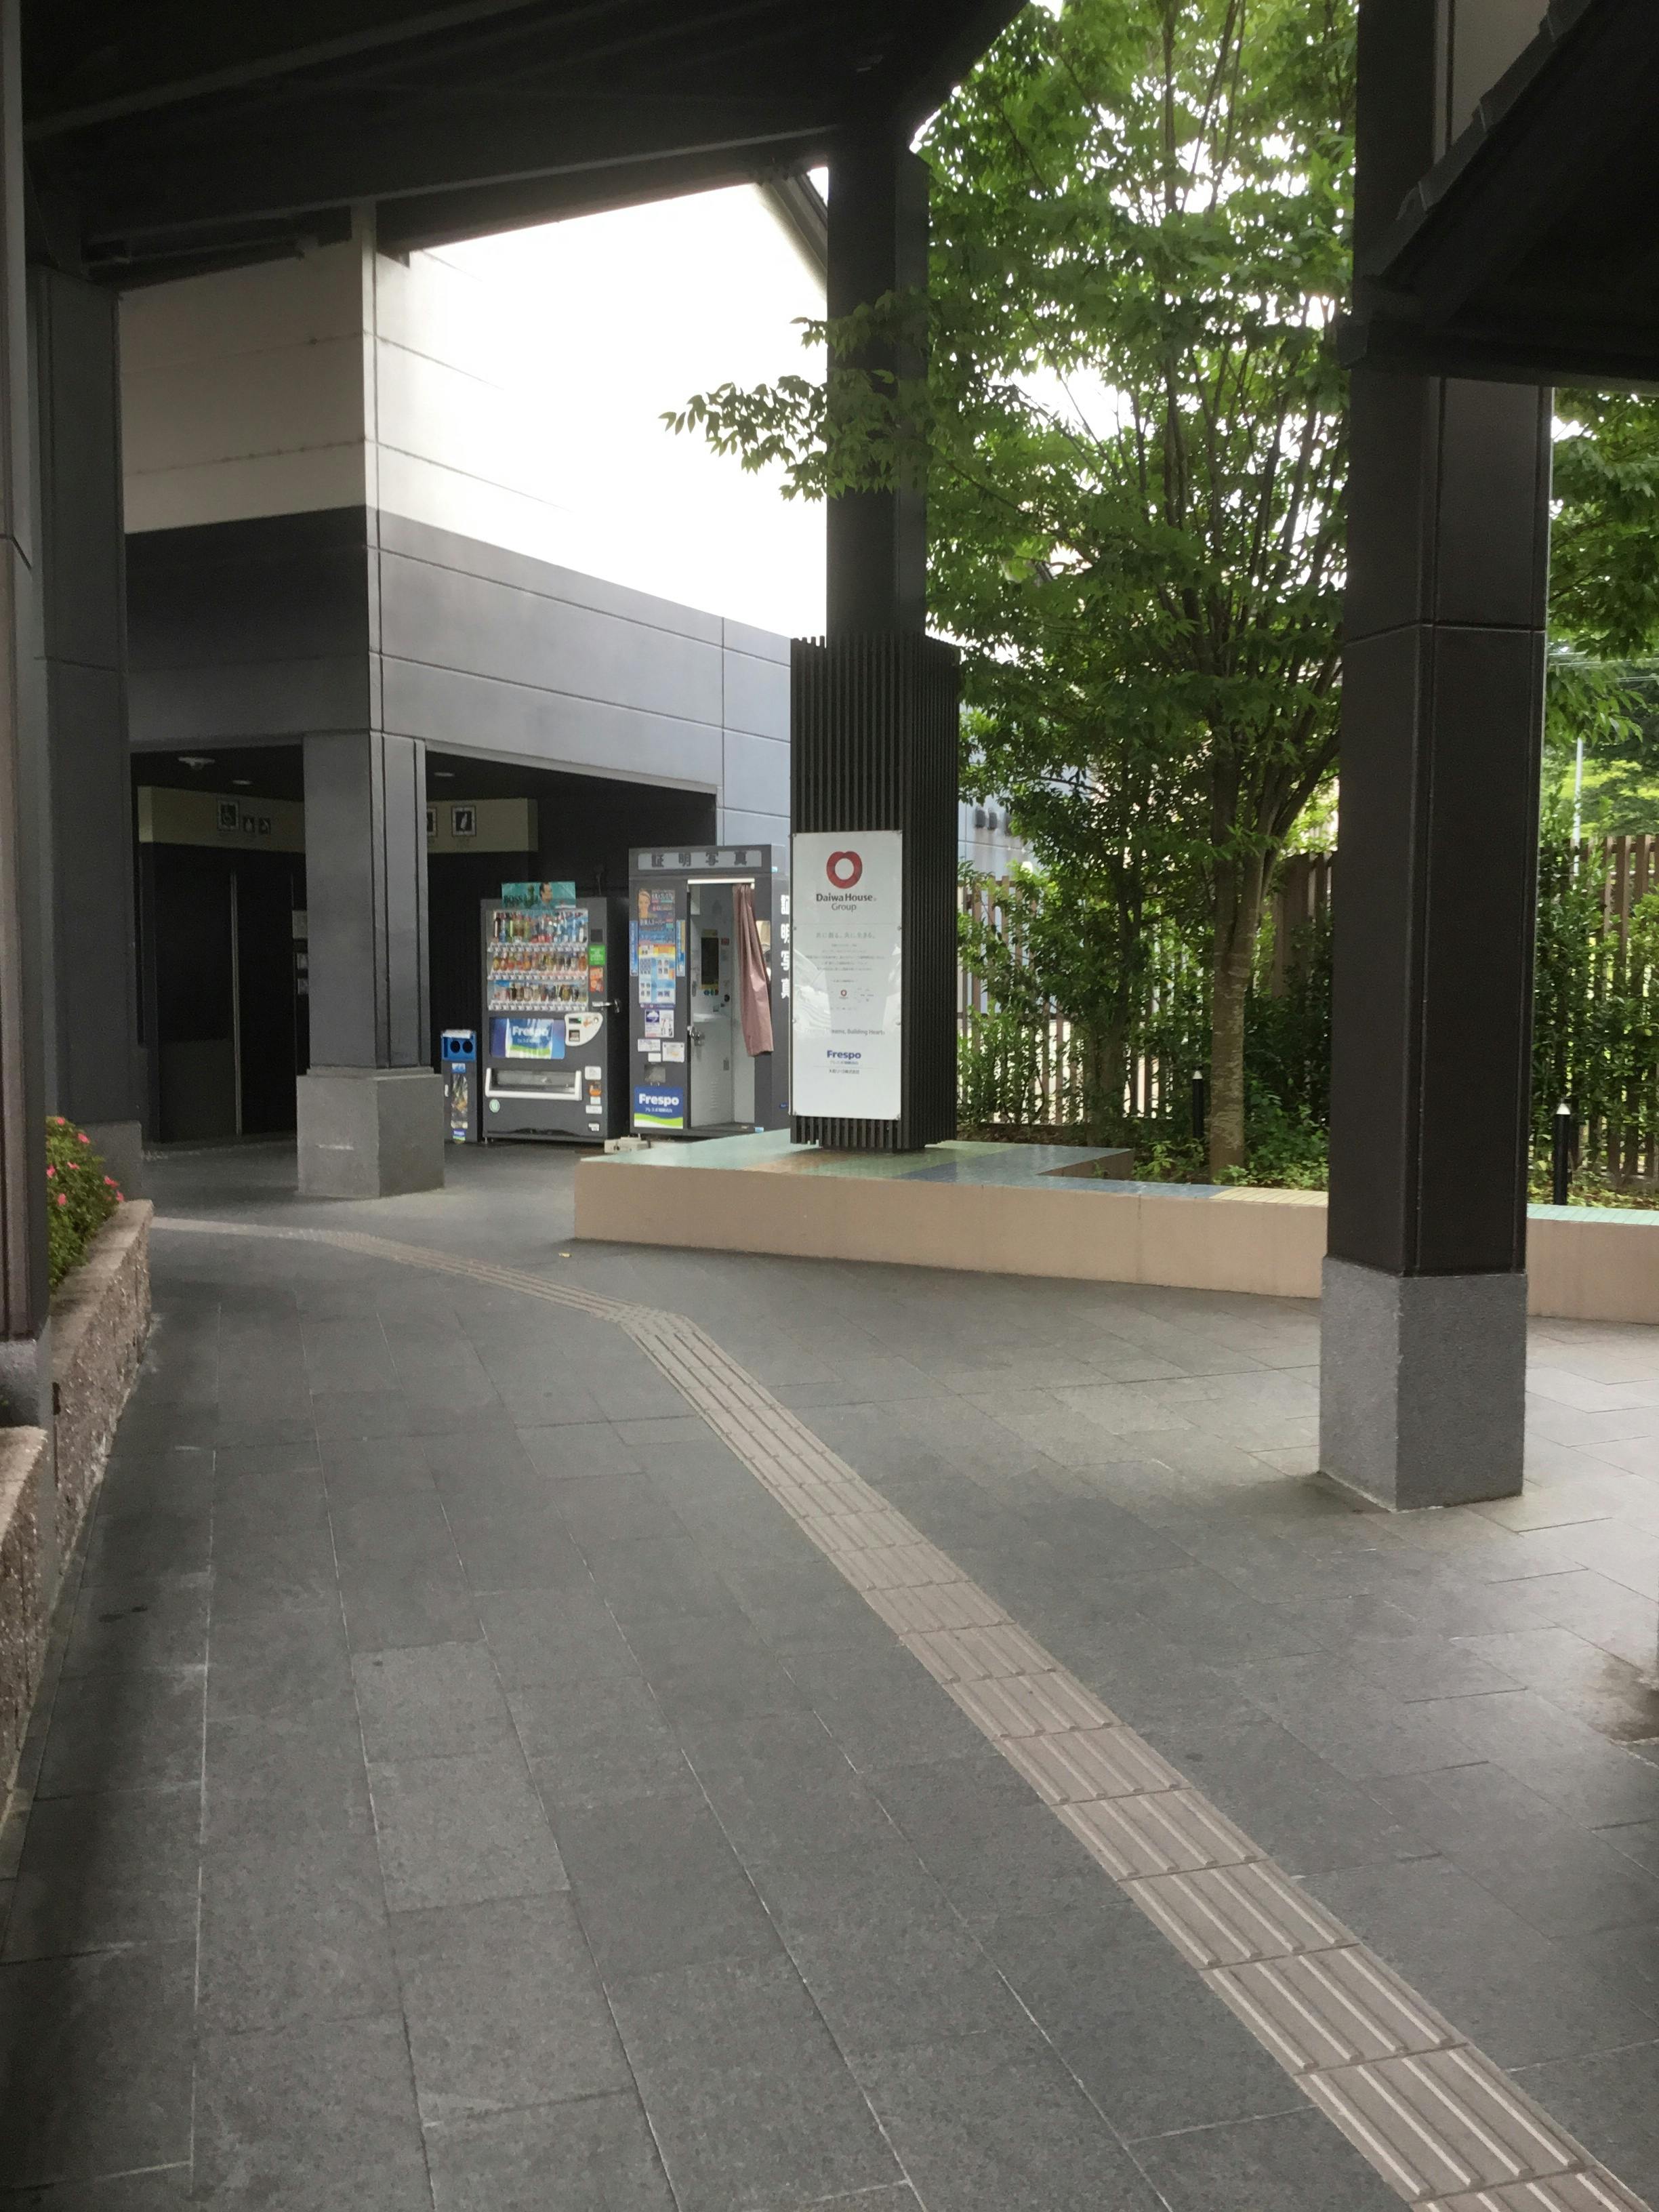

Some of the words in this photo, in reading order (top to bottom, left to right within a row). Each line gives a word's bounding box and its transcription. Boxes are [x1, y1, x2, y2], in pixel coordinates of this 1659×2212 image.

[651, 851, 747, 867] 証明写真
[816, 893, 844, 901] Daiwa
[844, 893, 873, 901] House
[831, 903, 857, 912] Group
[827, 1050, 861, 1060] Frespo
[638, 1093, 680, 1107] Frespo
